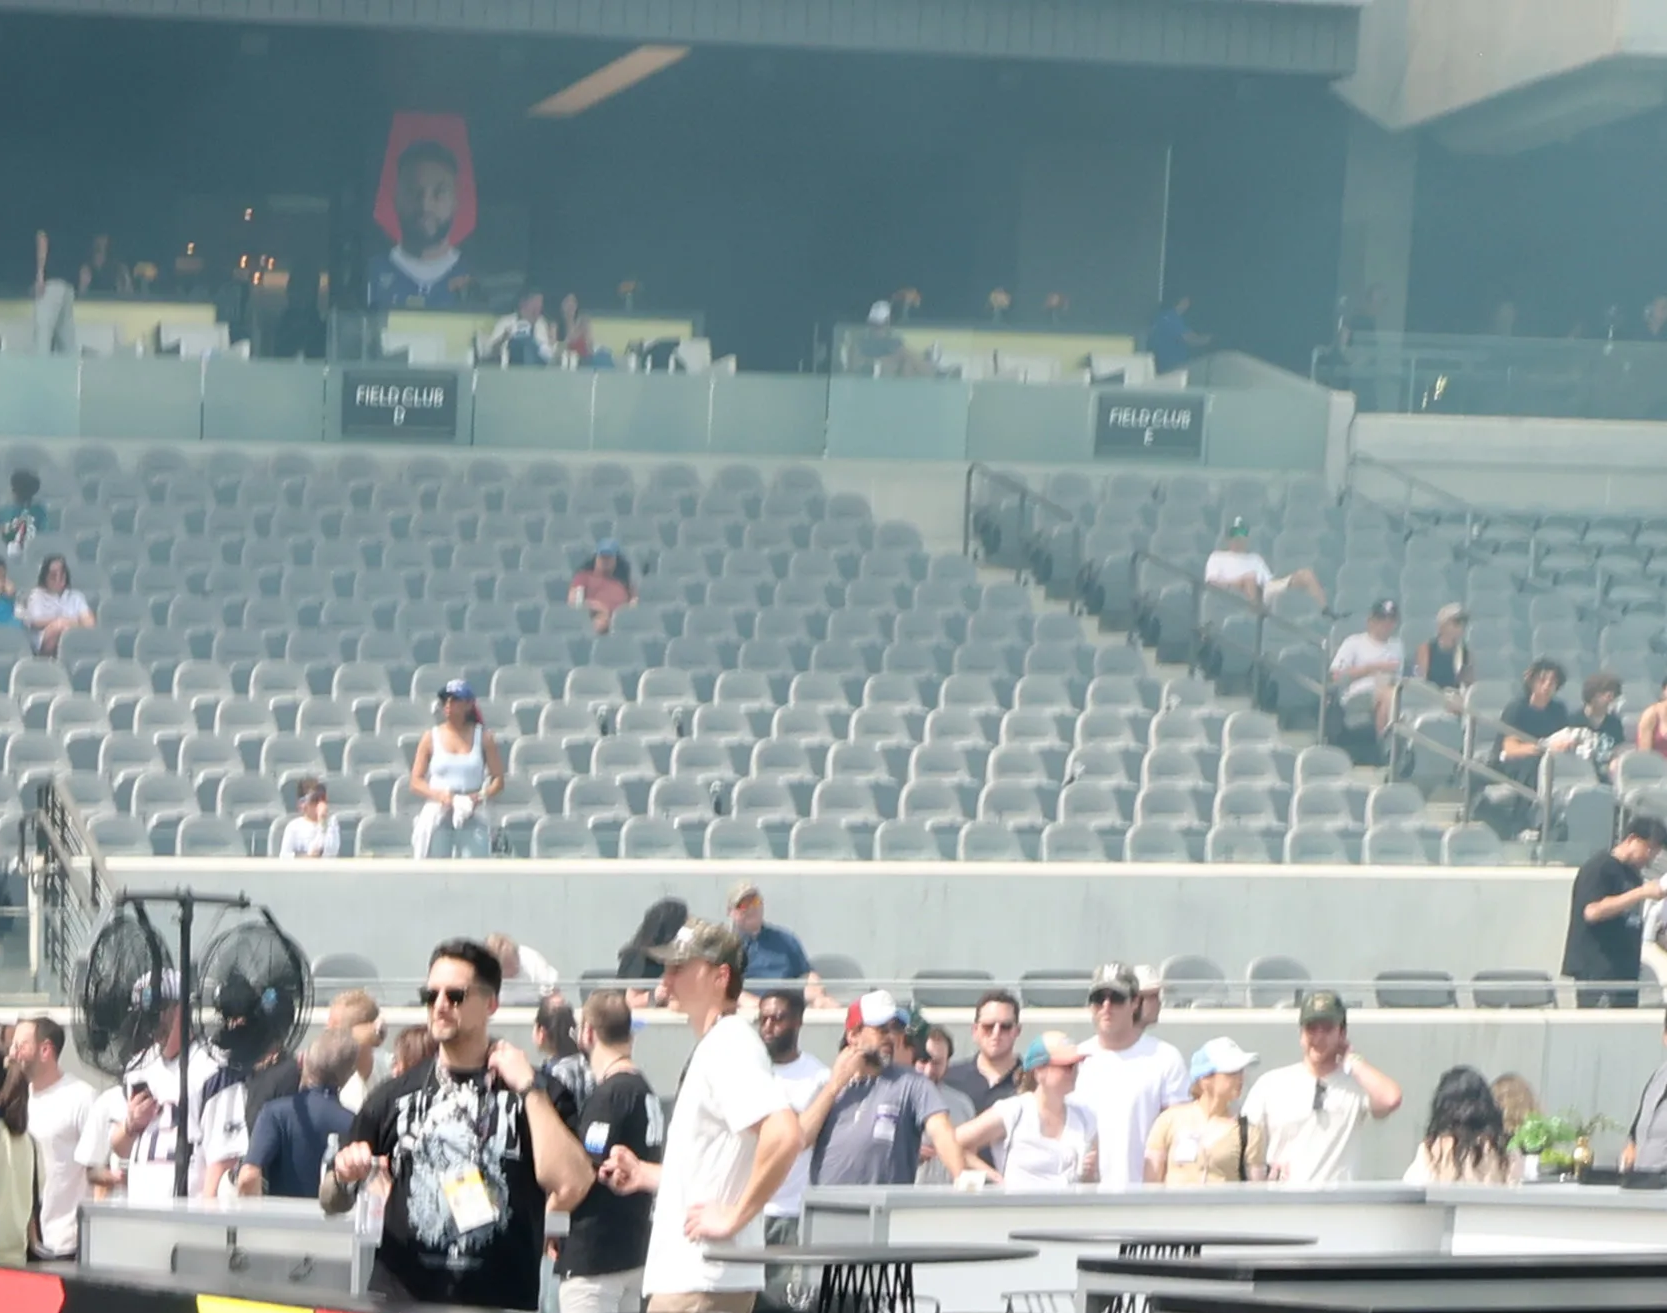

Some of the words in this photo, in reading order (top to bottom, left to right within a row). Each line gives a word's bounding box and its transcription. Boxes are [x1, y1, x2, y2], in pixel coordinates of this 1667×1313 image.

[355, 385, 400, 407] FIELD
[402, 386, 444, 408] CLUB
[1109, 407, 1151, 428] FIELD
[1152, 408, 1192, 430] CLUB
